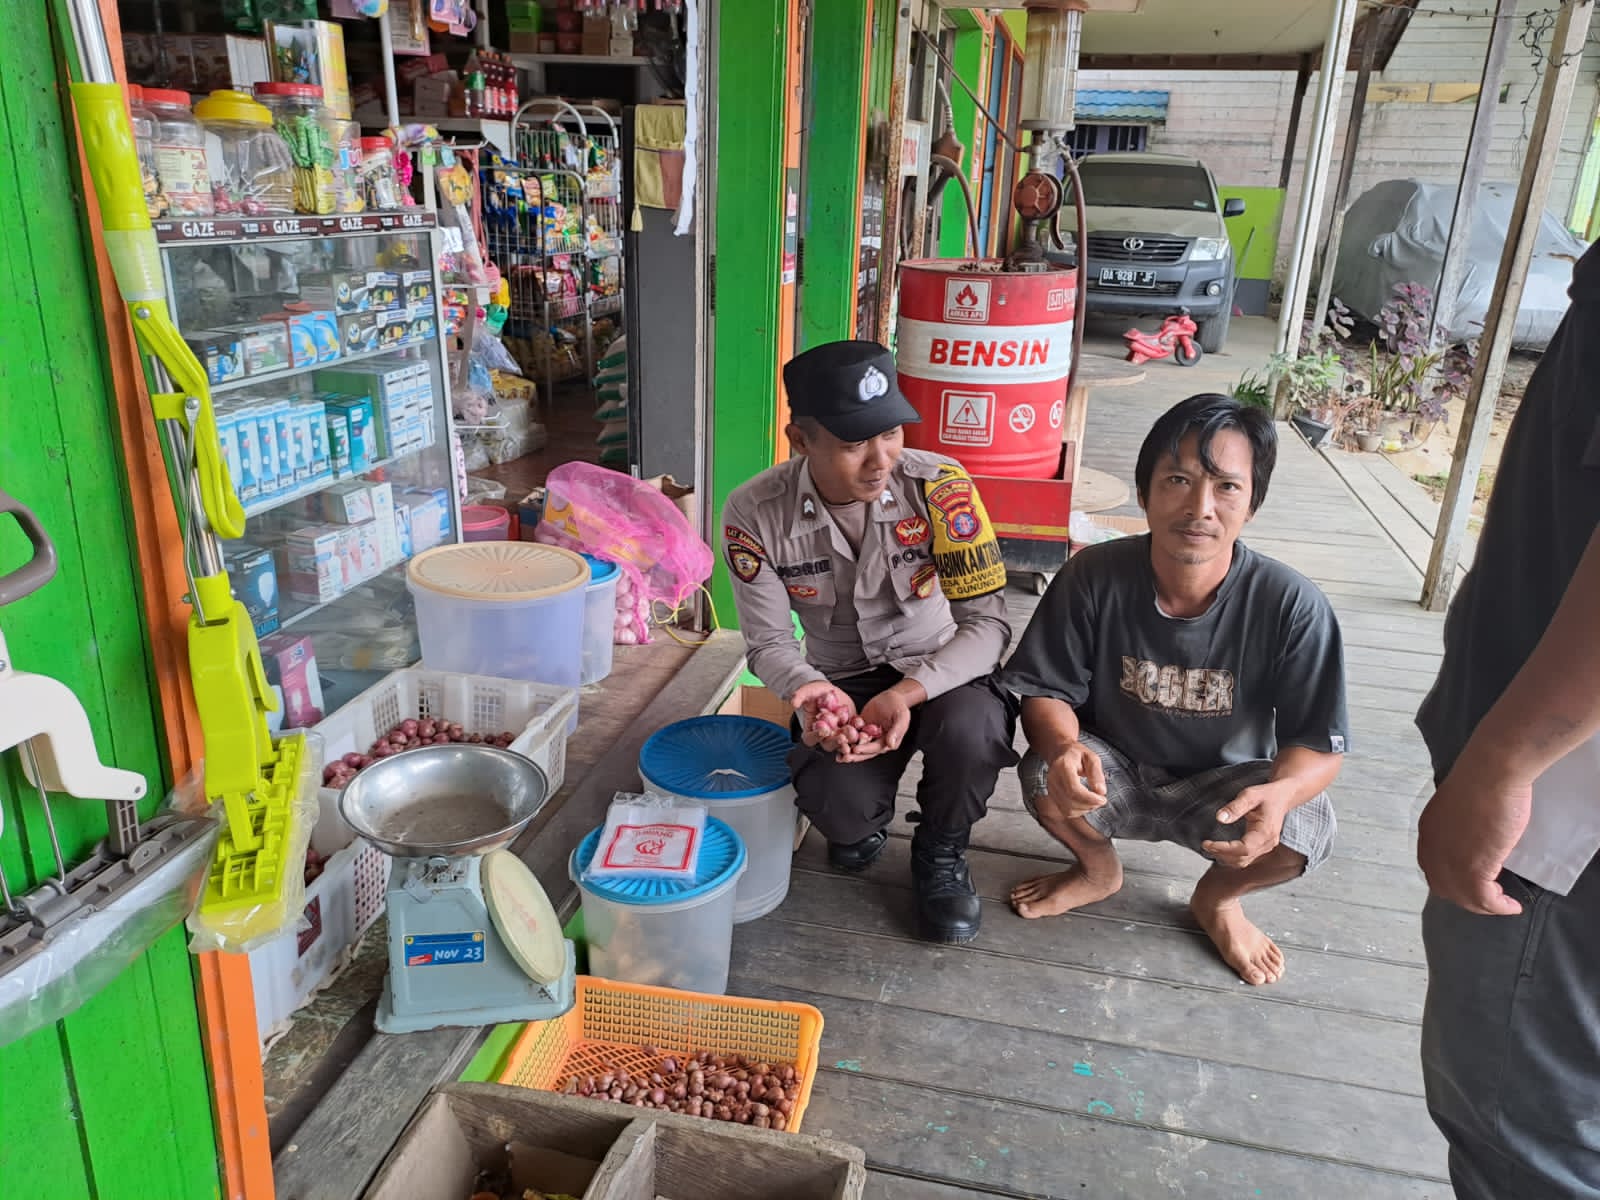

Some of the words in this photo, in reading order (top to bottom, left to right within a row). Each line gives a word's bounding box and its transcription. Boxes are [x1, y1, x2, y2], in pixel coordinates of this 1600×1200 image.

[273, 220, 300, 233] GAZE
[340, 217, 363, 231] GAZE
[403, 215, 423, 227] GAZE
[182, 222, 215, 237] GAZE
[929, 338, 1050, 367] BENSIN
[434, 949, 459, 960] NOV
[463, 947, 482, 960] 23
